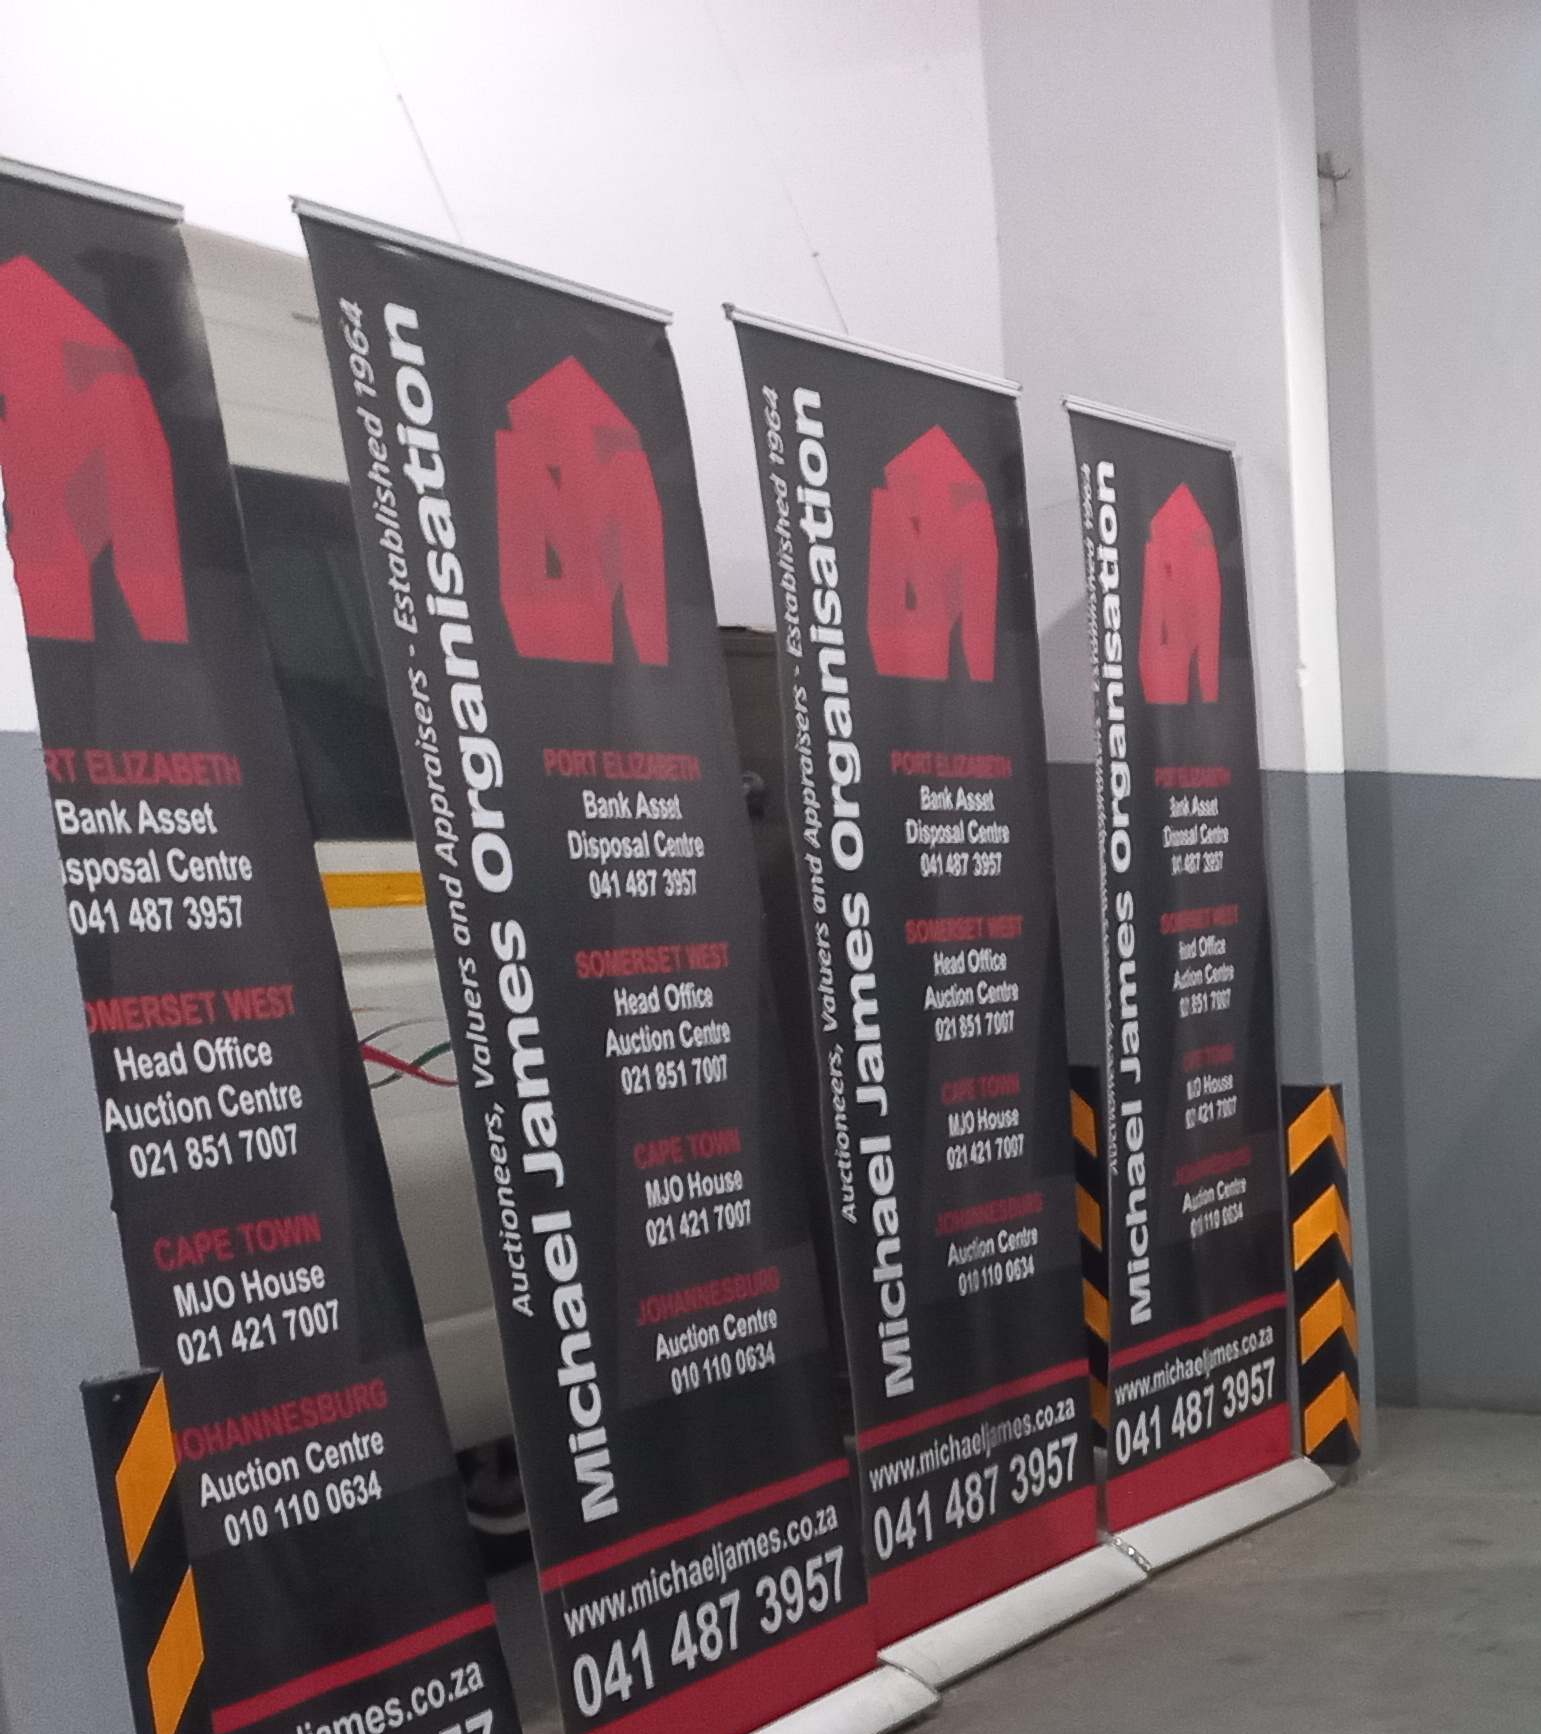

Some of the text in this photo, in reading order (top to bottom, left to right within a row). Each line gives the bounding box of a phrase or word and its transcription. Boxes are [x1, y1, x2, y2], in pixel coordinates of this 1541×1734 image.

[769, 473, 803, 658] Established
[1097, 461, 1131, 874] Organisation
[45, 748, 241, 785] RT ELIZABETH
[543, 748, 597, 778] PORT
[791, 685, 822, 849] Appraisers
[55, 799, 218, 835] Bank Asset
[339, 297, 535, 1317] Auctioneers, Valuers and Appraisers Established 1964
[583, 789, 683, 821] Bank Asset
[919, 785, 994, 812] Bank Asset
[568, 829, 705, 865] Disposal Centre
[905, 818, 1010, 848] Disposal Centre
[62, 848, 253, 892] sposal Centre
[589, 868, 697, 900] 041 487 3957
[804, 853, 828, 914] and
[920, 852, 943, 877] 041
[945, 852, 968, 876] 487
[69, 895, 243, 935] 041 487 3957
[384, 302, 620, 1522] Michael James Organisation
[793, 386, 915, 1399] Michael James Organisation
[575, 941, 729, 979] SOMERSET WEST
[933, 948, 1007, 976] Head Office
[86, 984, 295, 1034] MERSET WEST
[614, 982, 713, 1017] Head Office
[923, 980, 1019, 1010] Auction Centre
[1116, 890, 1141, 1085] James
[605, 1018, 731, 1058] Auction Centre
[935, 1016, 957, 1042] 021
[959, 1012, 982, 1037] 851
[113, 1037, 273, 1082] Head Office
[621, 1055, 728, 1096] 021 851 7007
[105, 1081, 303, 1133] Auction Centre
[977, 1107, 1019, 1131] House
[130, 1123, 299, 1180] 021 851 7007
[633, 1127, 742, 1169] CAPE TOWN
[947, 1133, 1024, 1171] 021 421 7007
[645, 1168, 743, 1209] MJO House
[645, 1199, 752, 1248] 021 421 7007
[1121, 1099, 1151, 1326] Michael
[154, 1212, 322, 1272] CAPE TOWN
[947, 1226, 1038, 1267] Auction Centre
[173, 1263, 326, 1318] MJO House
[958, 1254, 1035, 1297] 010 110 0634
[177, 1299, 340, 1366] 021 421 7007
[655, 1306, 778, 1363] Auction Centre
[670, 1340, 776, 1396] 010 110 0634
[1115, 1357, 1276, 1466] 041 487 3957
[869, 1397, 1075, 1492] www.michaeljames.co.za
[200, 1429, 385, 1508] Auction Centre
[224, 1470, 382, 1547] 010 110 0634
[874, 1432, 1078, 1561] 041 487 3957
[564, 1503, 839, 1638] www.michaeljames.co.za
[572, 1545, 845, 1718] 041 487 3957
